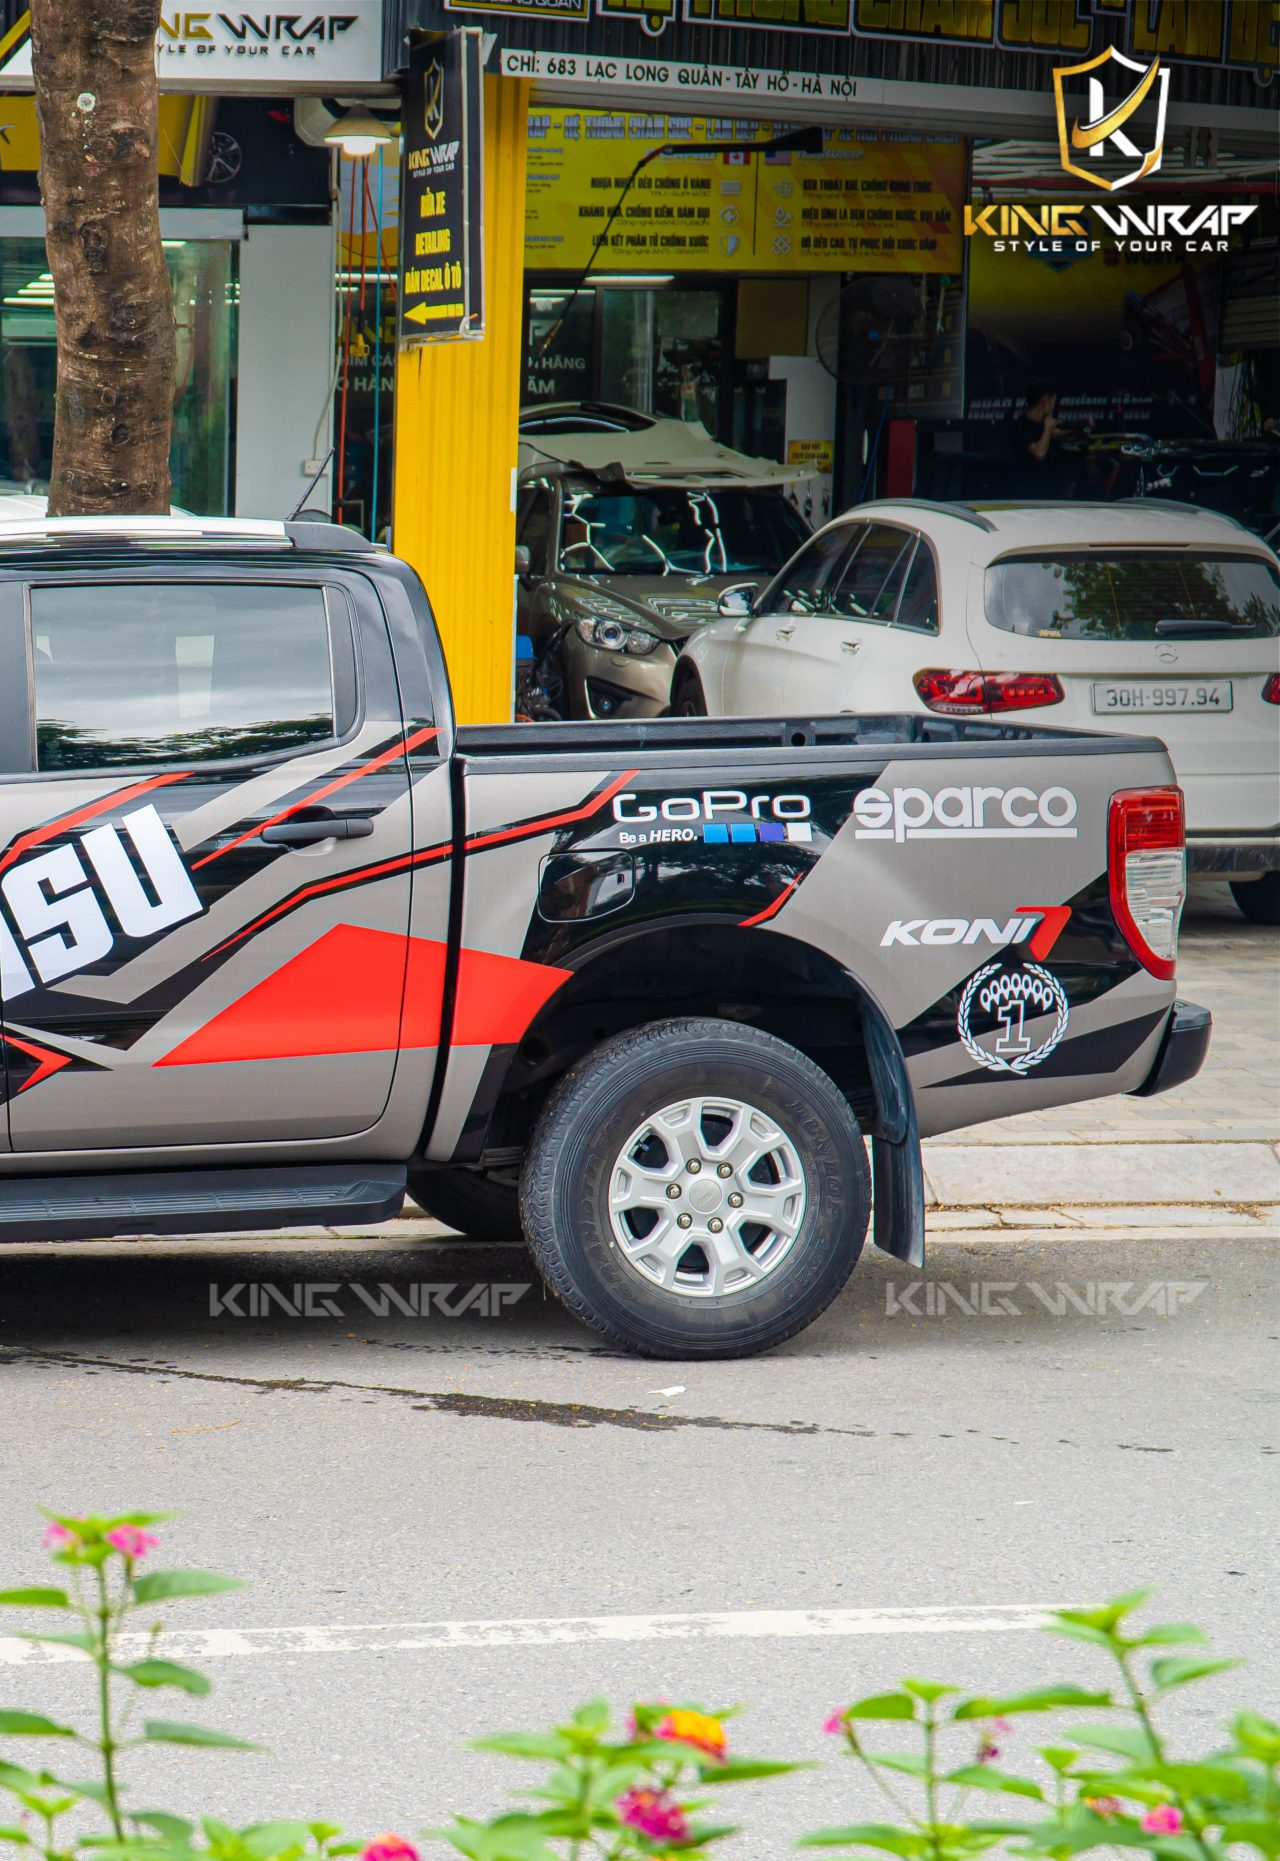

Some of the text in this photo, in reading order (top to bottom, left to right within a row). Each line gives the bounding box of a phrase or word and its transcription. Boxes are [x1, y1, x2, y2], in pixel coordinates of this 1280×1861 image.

[160, 13, 359, 40] NG WRAP
[157, 44, 316, 55] YLE OF YOUR CAR
[547, 57, 577, 75] 683
[625, 63, 669, 83] LONG
[408, 141, 460, 170] KING WRAP
[415, 228, 450, 256] DETAILING
[421, 268, 444, 292] DECAL
[1107, 688, 1219, 706] 30H-997.94
[612, 791, 811, 822] GoPro
[854, 787, 1077, 842] sparco
[620, 828, 698, 843] Be a HERO.
[996, 1000, 1031, 1052] 1
